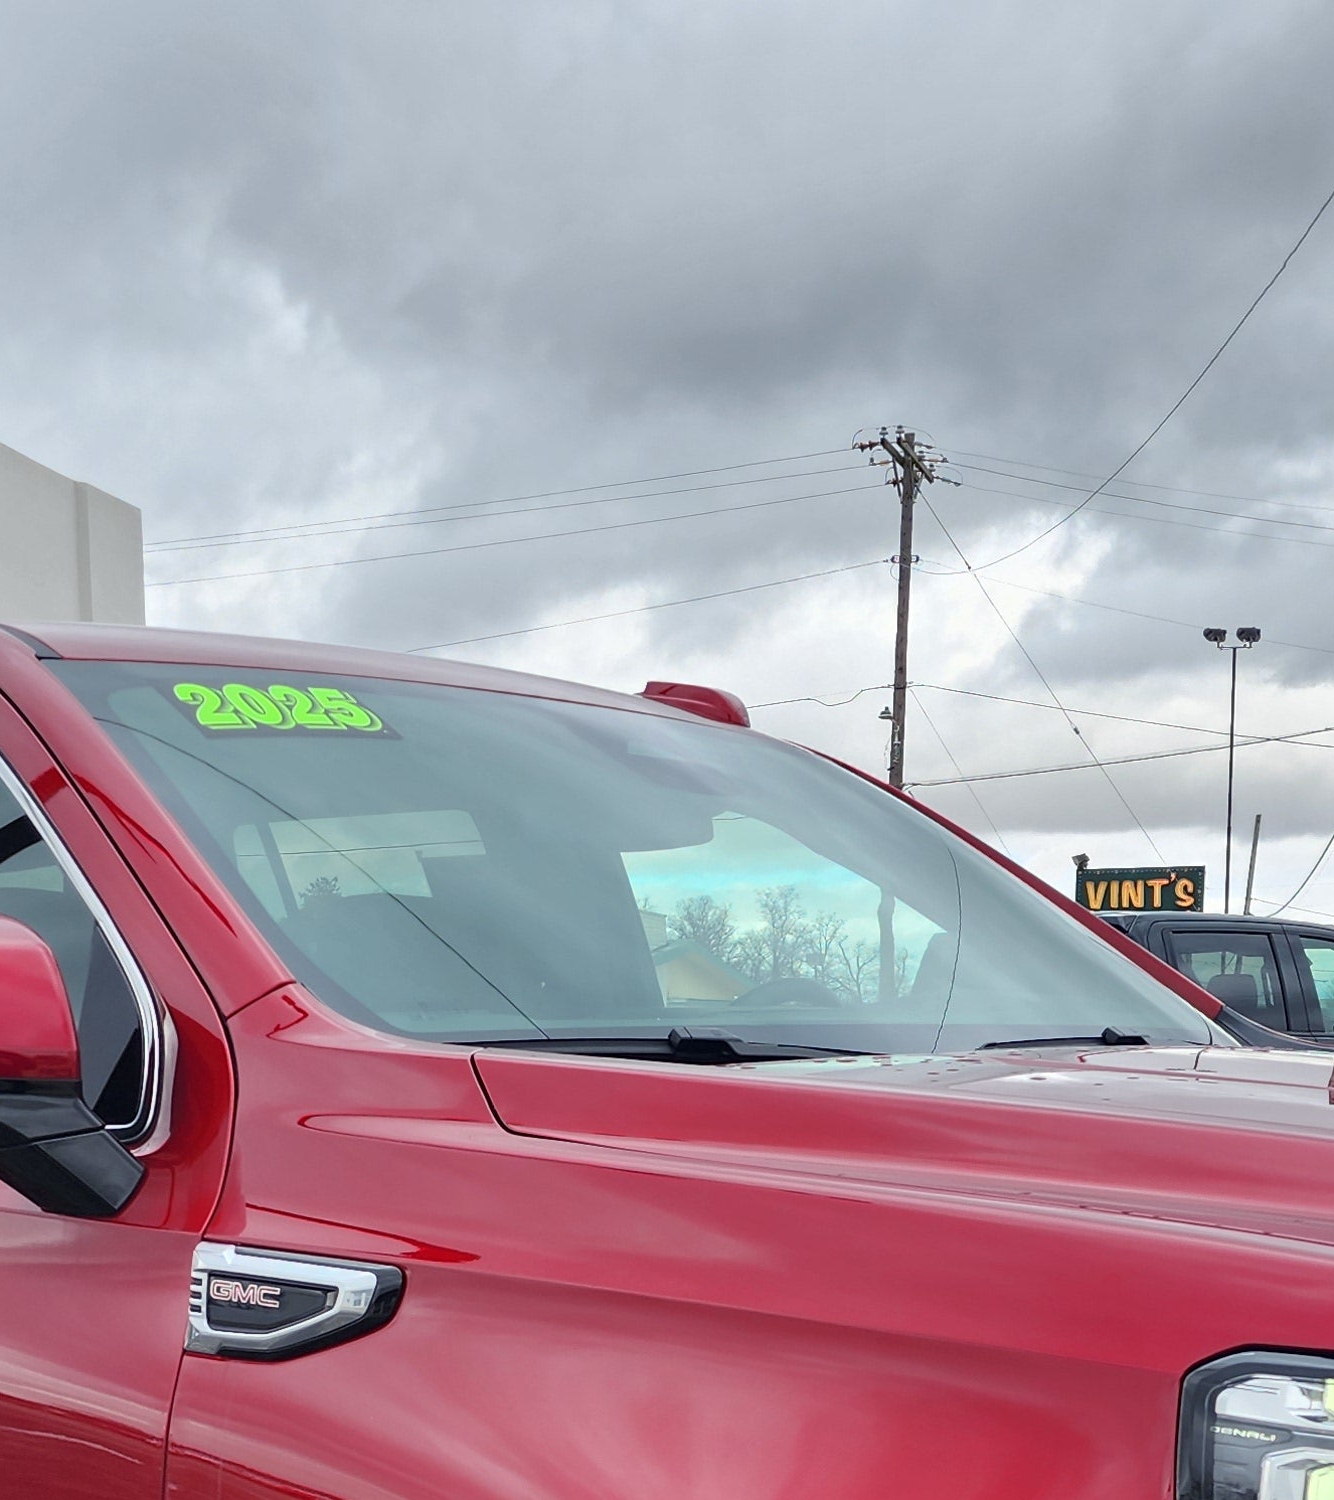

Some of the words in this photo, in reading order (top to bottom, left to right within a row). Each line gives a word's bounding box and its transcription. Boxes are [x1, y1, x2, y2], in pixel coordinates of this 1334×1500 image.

[173, 683, 383, 731] 2025
[1085, 871, 1195, 910] VINT'S
[210, 1279, 280, 1308] GMC
[1209, 1425, 1276, 1442] DENALI
